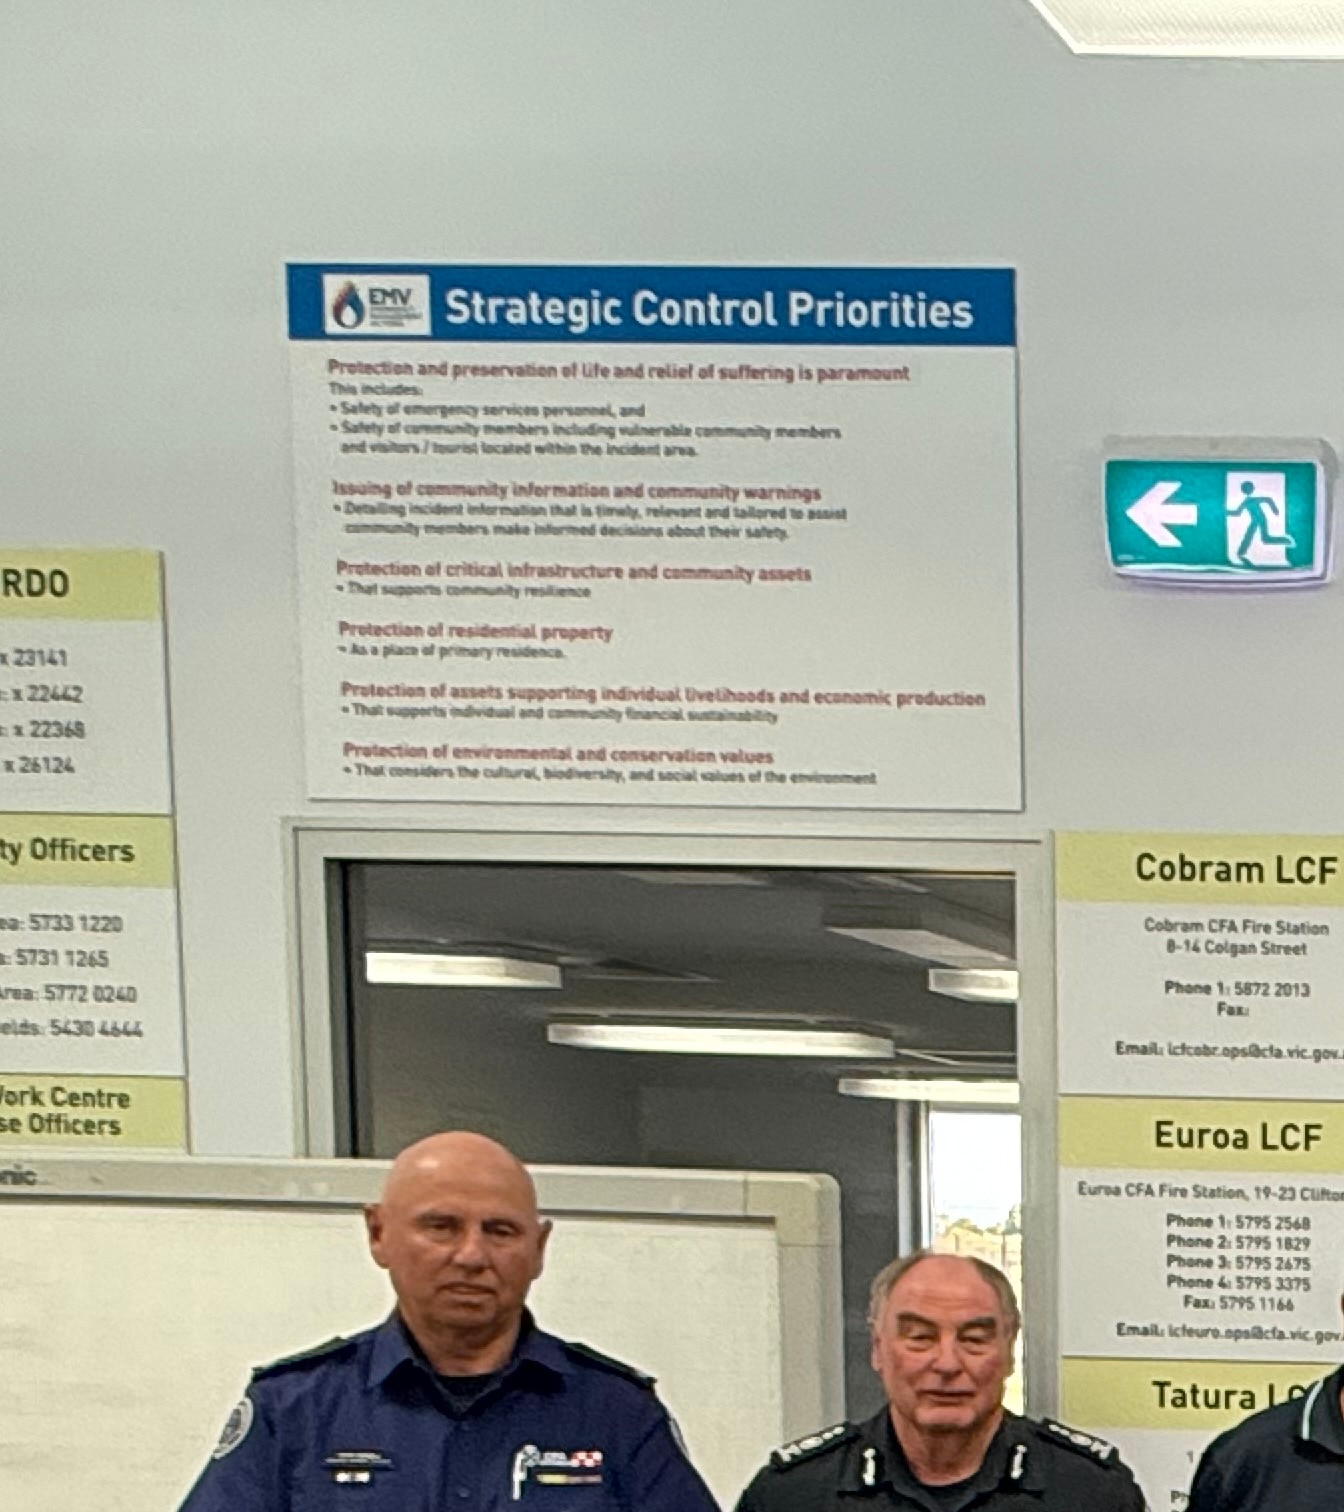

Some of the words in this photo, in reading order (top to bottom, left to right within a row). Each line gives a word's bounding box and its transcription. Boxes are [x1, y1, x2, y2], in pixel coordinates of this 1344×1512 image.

[368, 288, 412, 305] EMV
[446, 289, 622, 332] Strategic
[633, 291, 778, 325] Control
[789, 291, 973, 328] Priorities
[327, 359, 413, 377] Protection
[417, 361, 448, 376] and
[451, 363, 557, 380] preservation
[561, 362, 578, 378] of
[582, 363, 611, 379] life
[613, 363, 645, 380] and
[648, 363, 693, 379] relief
[698, 363, 715, 379] of
[717, 365, 795, 384] suffering
[799, 364, 813, 381] is
[817, 366, 911, 384] paramount
[331, 480, 393, 499] Issuing
[396, 481, 413, 496] of
[415, 482, 509, 502] community
[512, 482, 610, 498] information
[613, 483, 645, 499] and
[647, 484, 741, 502] community
[743, 488, 822, 503] warnings
[336, 559, 421, 576] Protection
[425, 561, 441, 577] of
[445, 562, 503, 577] critical
[507, 562, 624, 579] infrastructure
[628, 564, 659, 580] and
[663, 566, 755, 584] community
[758, 567, 812, 581] assets
[338, 621, 425, 637] Protection
[427, 623, 443, 637] of
[447, 623, 537, 639] residential
[541, 627, 613, 643] property
[339, 681, 427, 698] Protection
[430, 683, 447, 699] of
[449, 686, 503, 699] assets
[506, 687, 597, 705] supporting
[601, 686, 682, 702] individual
[685, 687, 775, 703] livelihoods
[779, 689, 810, 704] and
[813, 691, 891, 705] economic
[897, 691, 986, 708] production
[343, 742, 428, 759] Protection
[431, 744, 449, 758] of
[452, 747, 573, 761] environmental
[576, 747, 607, 761] and
[609, 749, 717, 763] conservation
[719, 749, 775, 764] values
[30, 837, 135, 862] Officers
[1136, 853, 1264, 883] Cobram
[1277, 855, 1338, 885] LCF
[1144, 917, 1204, 933] Cobram
[1208, 919, 1238, 933] CFA
[1243, 919, 1272, 934] Fire
[1275, 920, 1329, 935] Station
[1167, 939, 1201, 953] 8-14
[1205, 940, 1257, 958] Colgan
[1261, 941, 1307, 955] Street
[1165, 980, 1212, 996] Phone
[1235, 981, 1270, 996] 5872
[1274, 983, 1311, 997] 2013
[1217, 1001, 1249, 1016] Fax:
[1115, 1041, 1164, 1056] Email:
[50, 1086, 131, 1109] Centre
[28, 1113, 122, 1135] Officers
[1155, 1120, 1249, 1150] Euroa
[1261, 1123, 1323, 1151] LCF
[1151, 1381, 1255, 1411] Tatura
